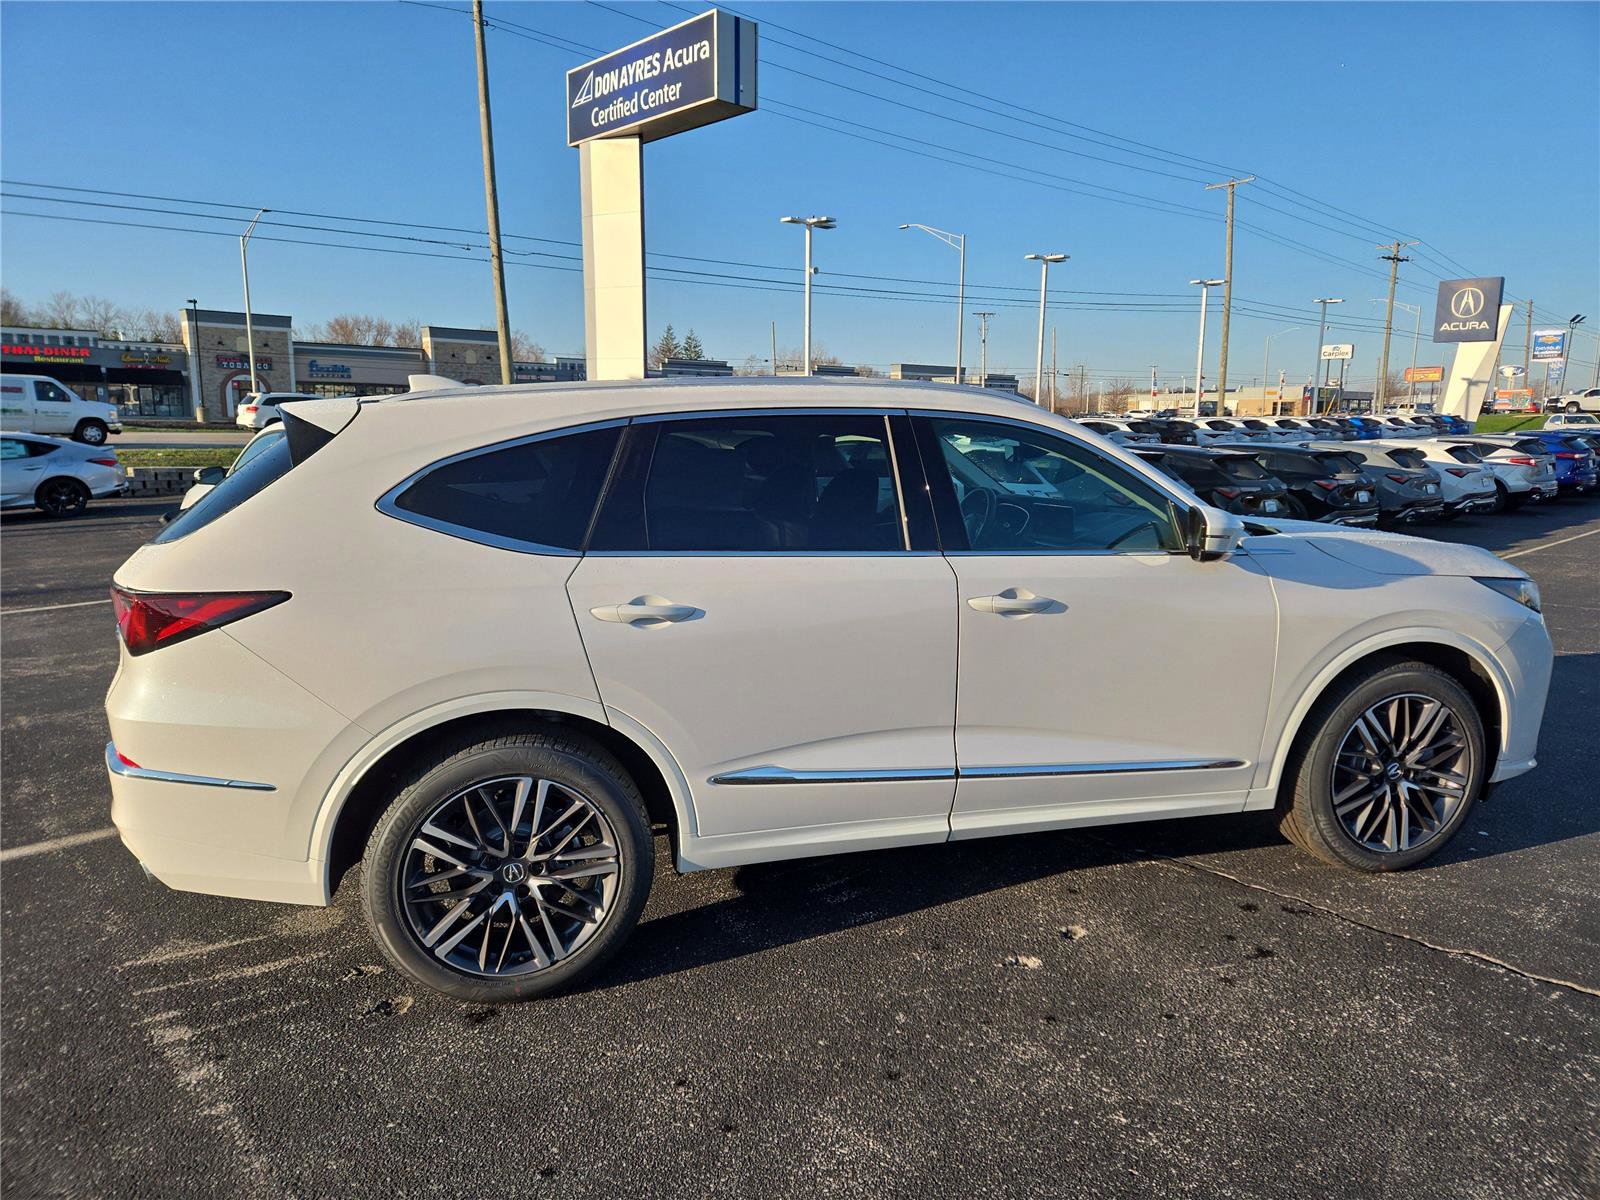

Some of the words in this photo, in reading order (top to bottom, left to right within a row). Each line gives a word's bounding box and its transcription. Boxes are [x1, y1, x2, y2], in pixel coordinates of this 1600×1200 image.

[594, 71, 619, 98] DON
[619, 52, 660, 89] AYRES
[663, 39, 710, 73] Acura
[591, 92, 638, 127] Certified
[640, 81, 682, 110] Center
[1439, 321, 1490, 331] ACURA
[43, 347, 91, 357] DINER
[1322, 350, 1349, 358] Carplex
[34, 355, 84, 364] Restaurant
[222, 361, 269, 370] TOBACO
